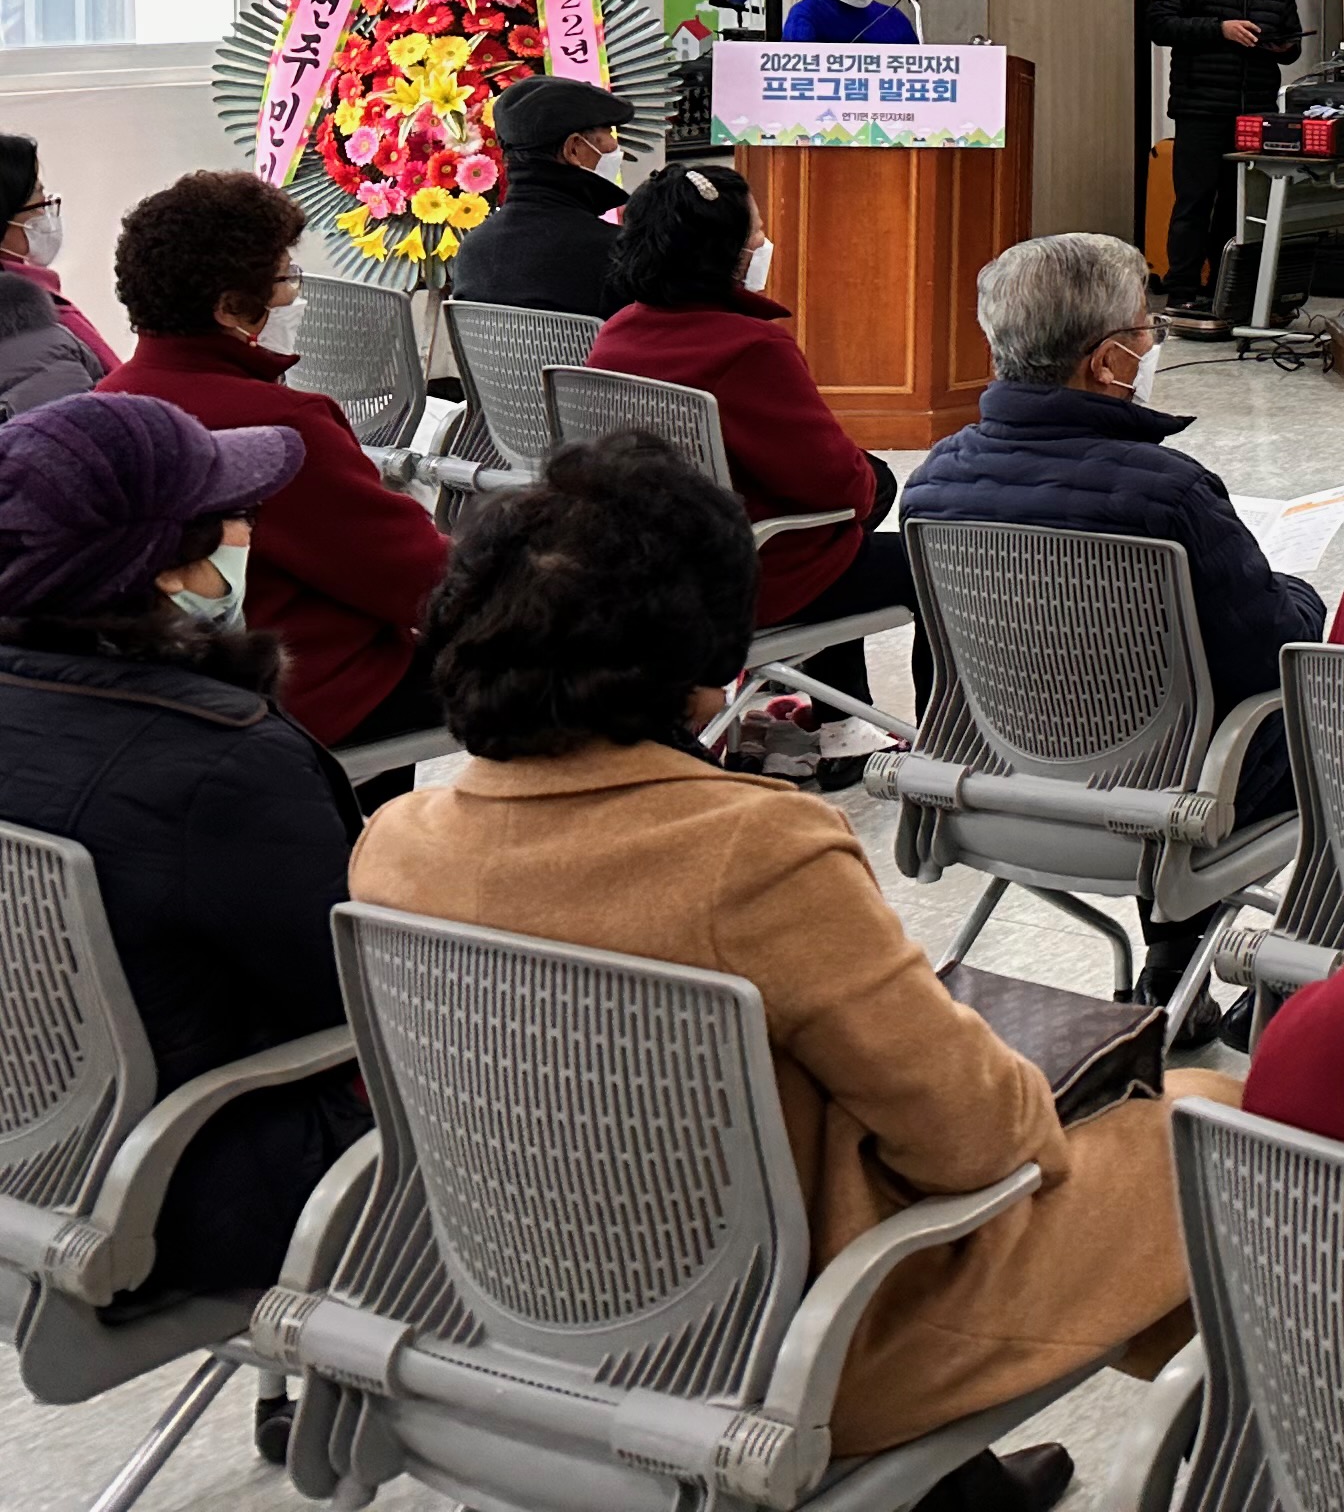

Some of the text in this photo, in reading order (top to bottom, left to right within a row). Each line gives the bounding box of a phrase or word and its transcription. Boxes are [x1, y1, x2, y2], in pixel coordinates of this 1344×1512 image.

[760, 53, 960, 75] 2022년 연기면 주민자치
[762, 76, 957, 103] 프로그램 발표회
